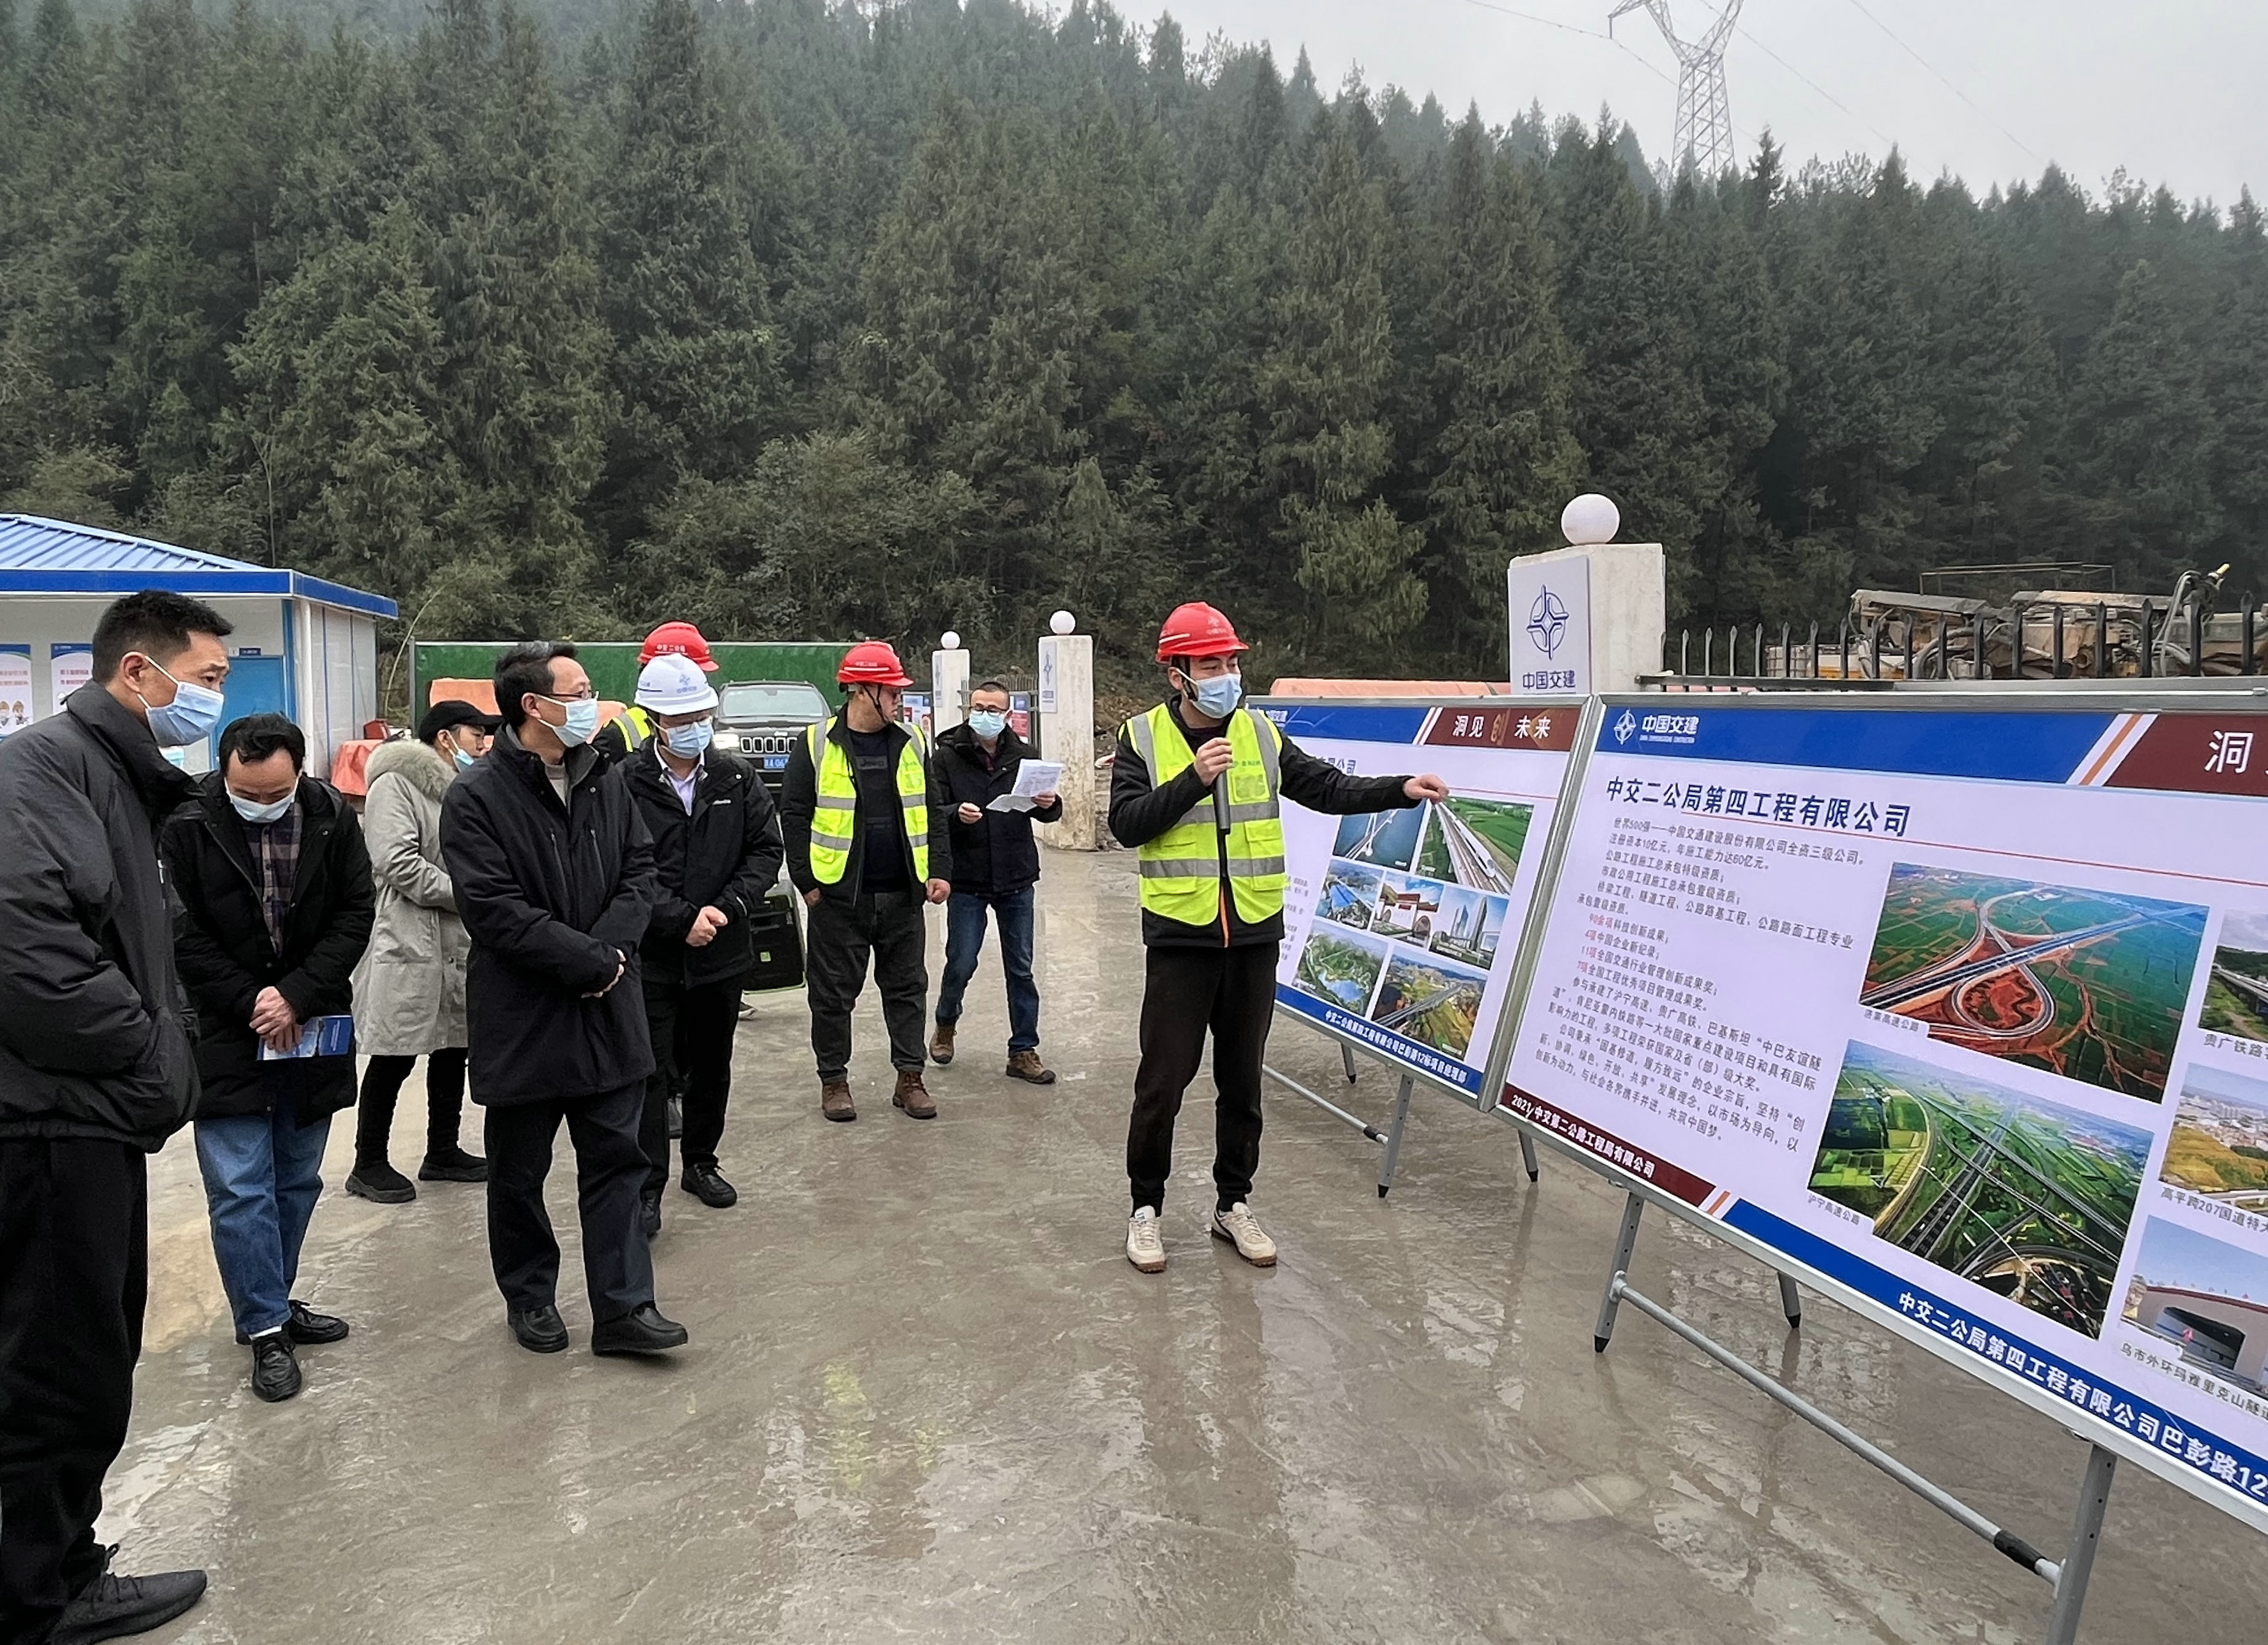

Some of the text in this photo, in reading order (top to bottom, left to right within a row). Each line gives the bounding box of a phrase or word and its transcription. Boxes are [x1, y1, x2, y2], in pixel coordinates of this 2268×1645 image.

[1522, 670, 1576, 689] 中国交建
[1453, 715, 1484, 738] 洞见
[1515, 715, 1551, 739] 未来
[1642, 715, 1699, 735] 中国交建
[2204, 730, 2268, 775] 洞
[1606, 776, 1911, 837] 中交二公局第四工程有限公司
[2204, 1033, 2268, 1060] 贵广铁路
[1899, 1291, 2268, 1497] 中交二公局第四工程有限公司巴彭路12
